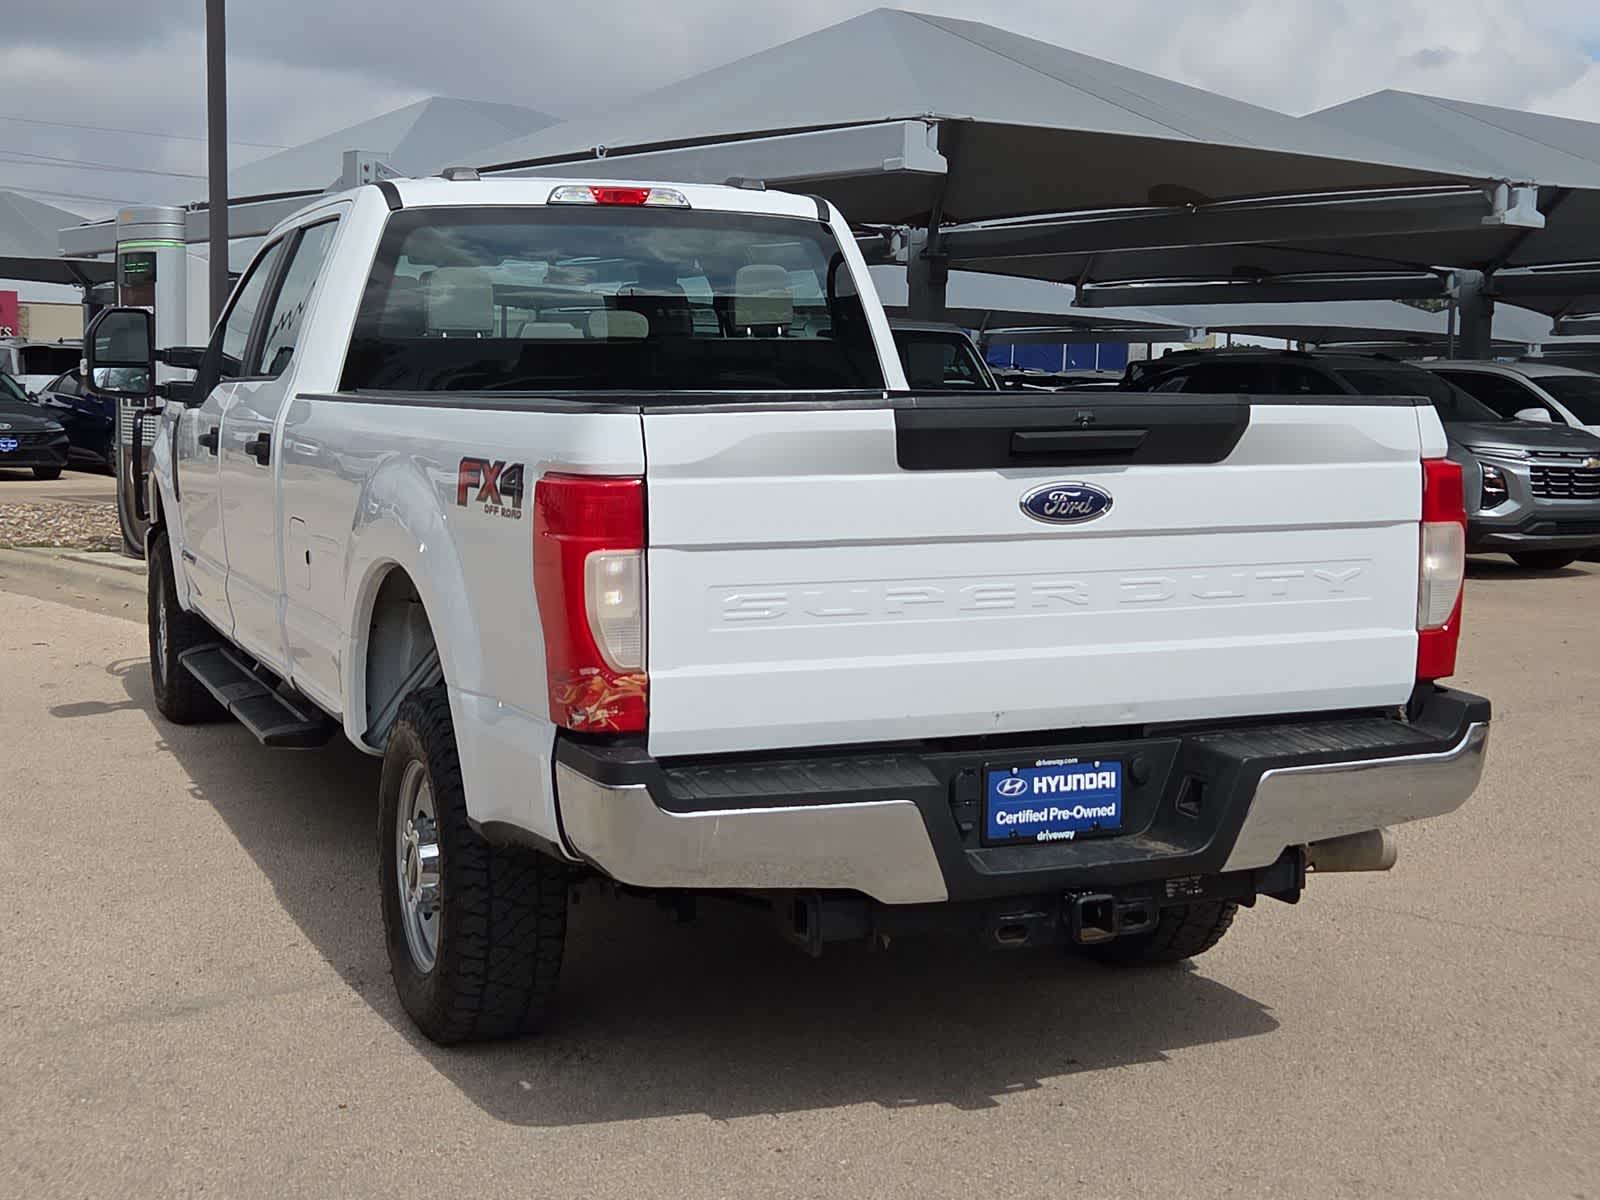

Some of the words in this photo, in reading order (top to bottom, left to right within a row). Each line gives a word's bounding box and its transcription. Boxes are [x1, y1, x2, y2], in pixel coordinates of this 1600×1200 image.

[457, 456, 525, 509] FX4
[484, 504, 500, 516] OFF
[501, 508, 522, 520] ROAD
[1043, 490, 1095, 515] Ford
[723, 579, 1088, 623] SUPER
[1119, 566, 1362, 605] DUTY
[1035, 757, 1079, 767] driveway.com
[1033, 771, 1117, 795] HYUNDAI
[995, 807, 1048, 825] Certified
[1049, 802, 1116, 820] Pre-Owned
[1036, 829, 1076, 842] driveway
